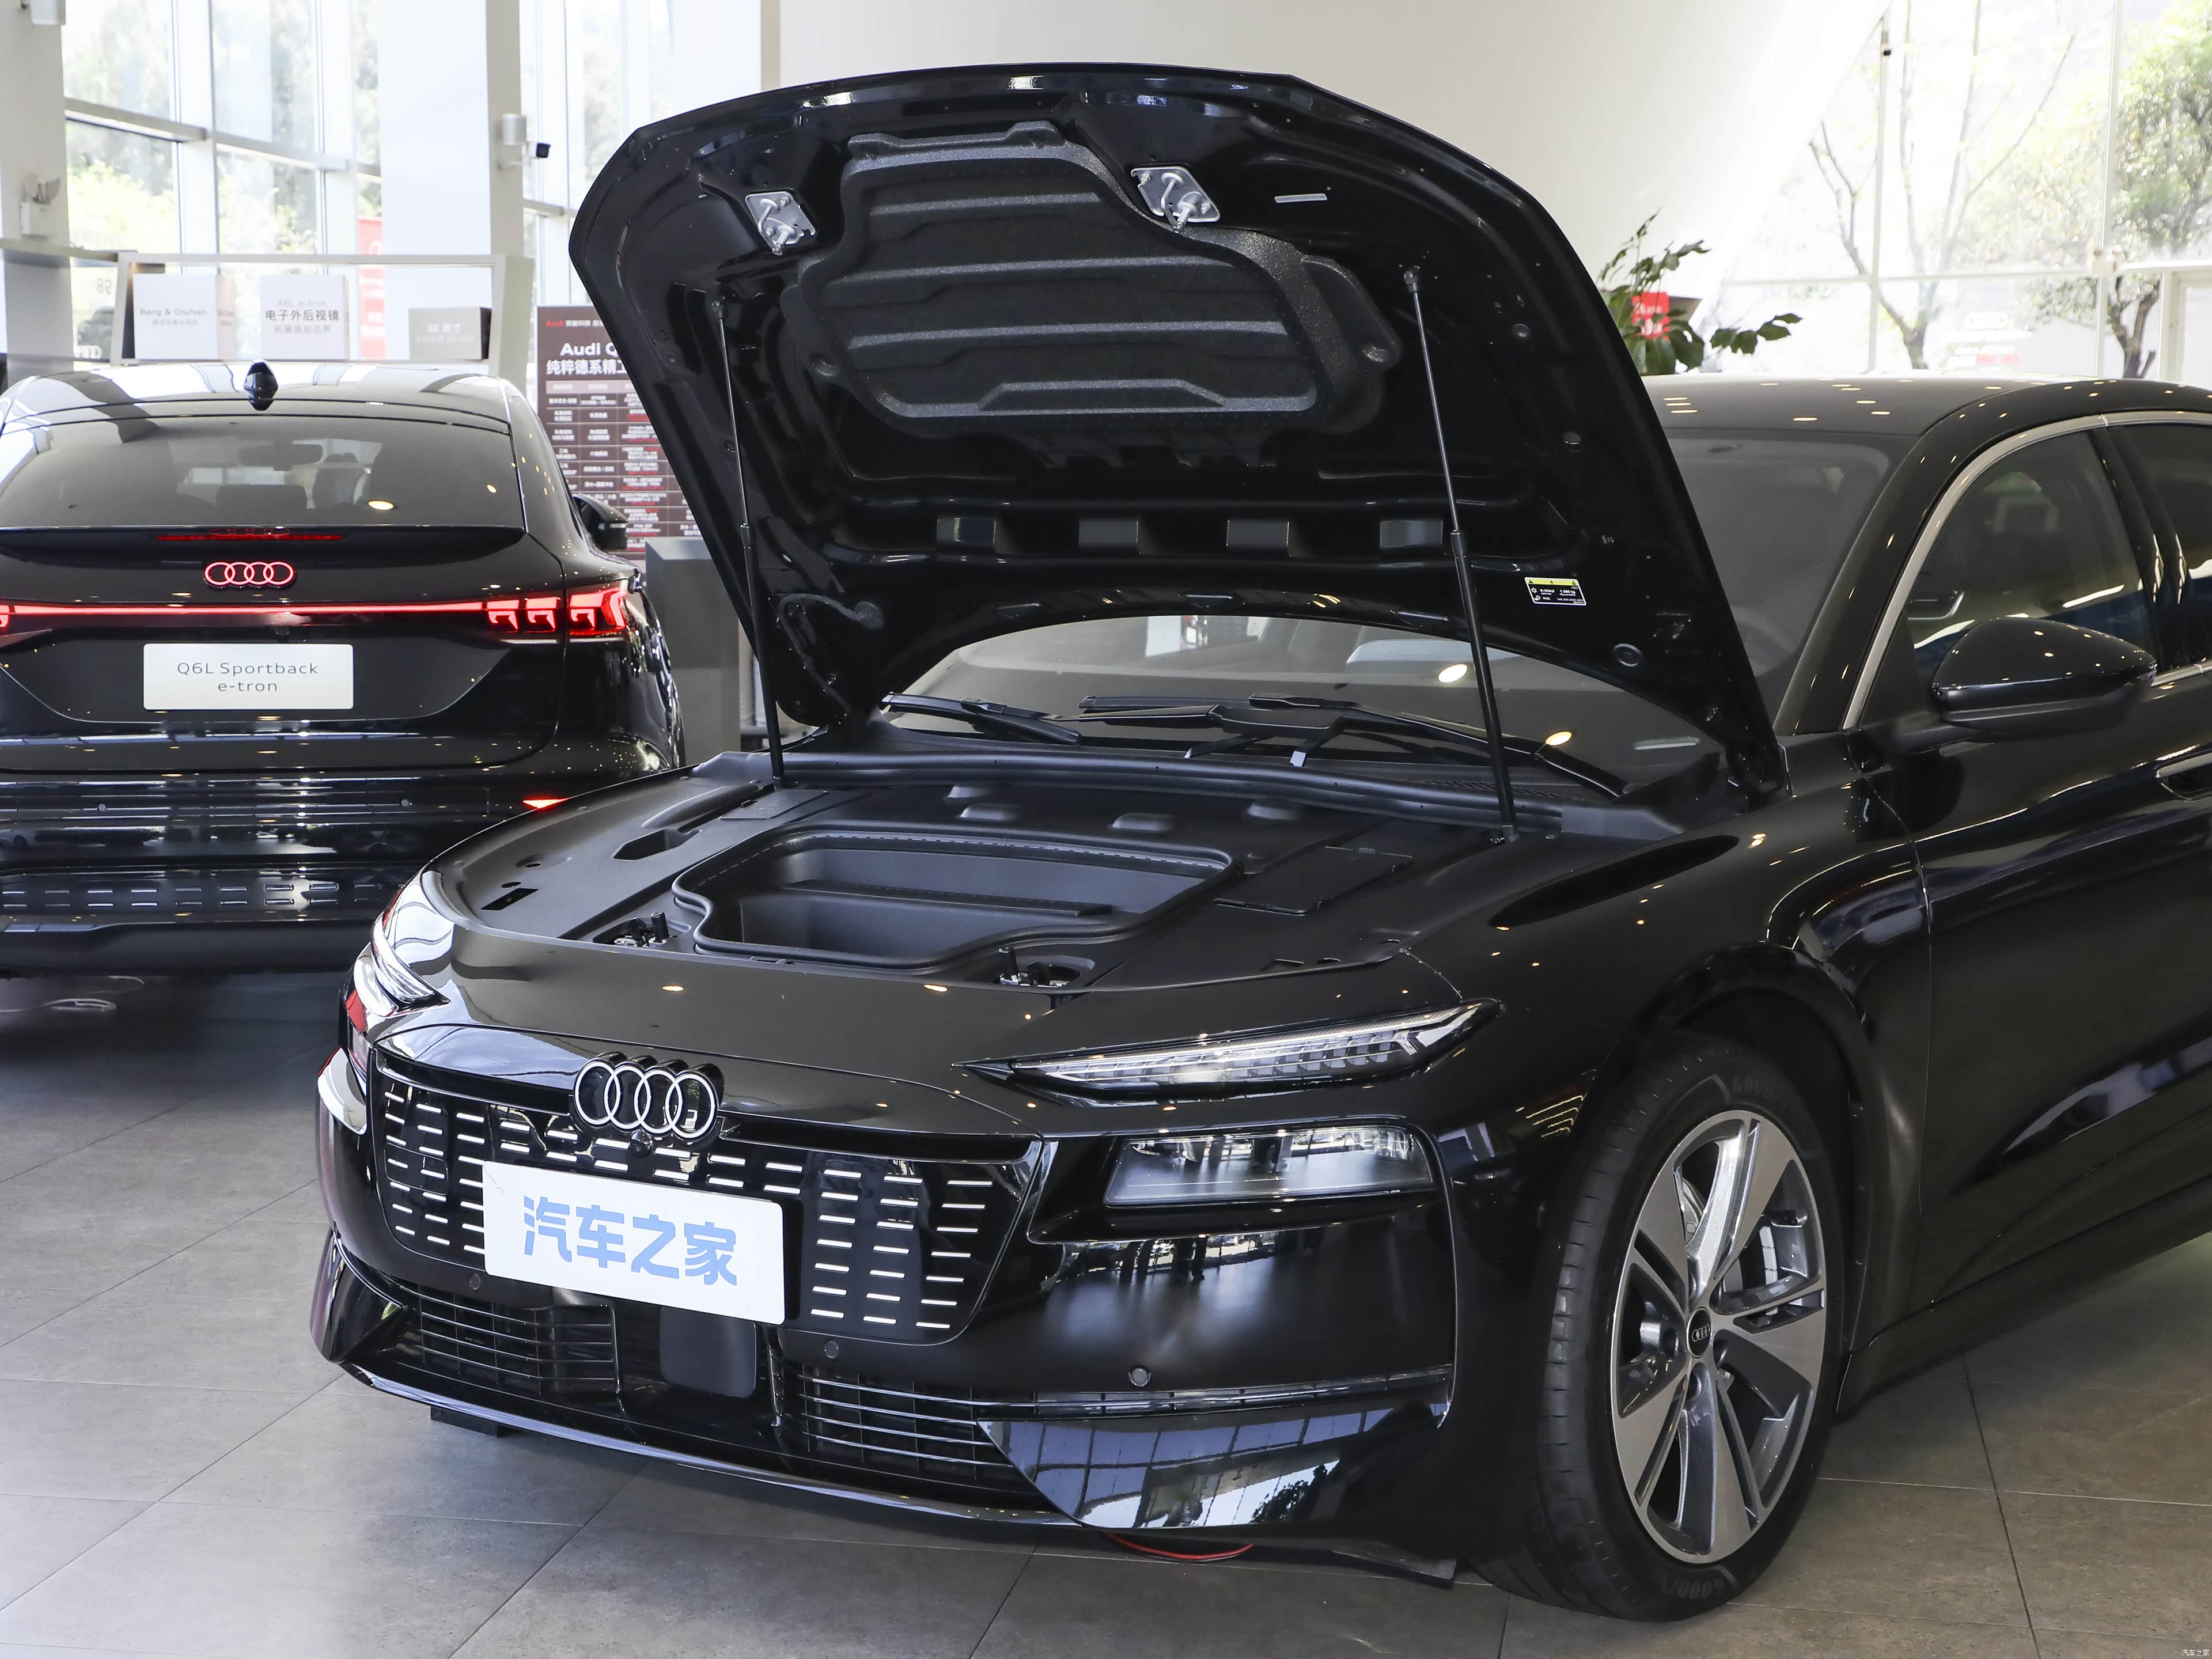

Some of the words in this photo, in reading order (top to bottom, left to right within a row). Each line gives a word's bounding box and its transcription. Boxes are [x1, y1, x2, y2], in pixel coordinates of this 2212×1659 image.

[139, 308, 162, 316] Bang
[265, 309, 339, 321] 电子外后视镜
[559, 342, 601, 357] Audi
[177, 662, 214, 676] Q6L
[220, 662, 319, 677] Sportback
[217, 680, 278, 692] e-tron
[523, 1195, 738, 1286] 汽车之家
